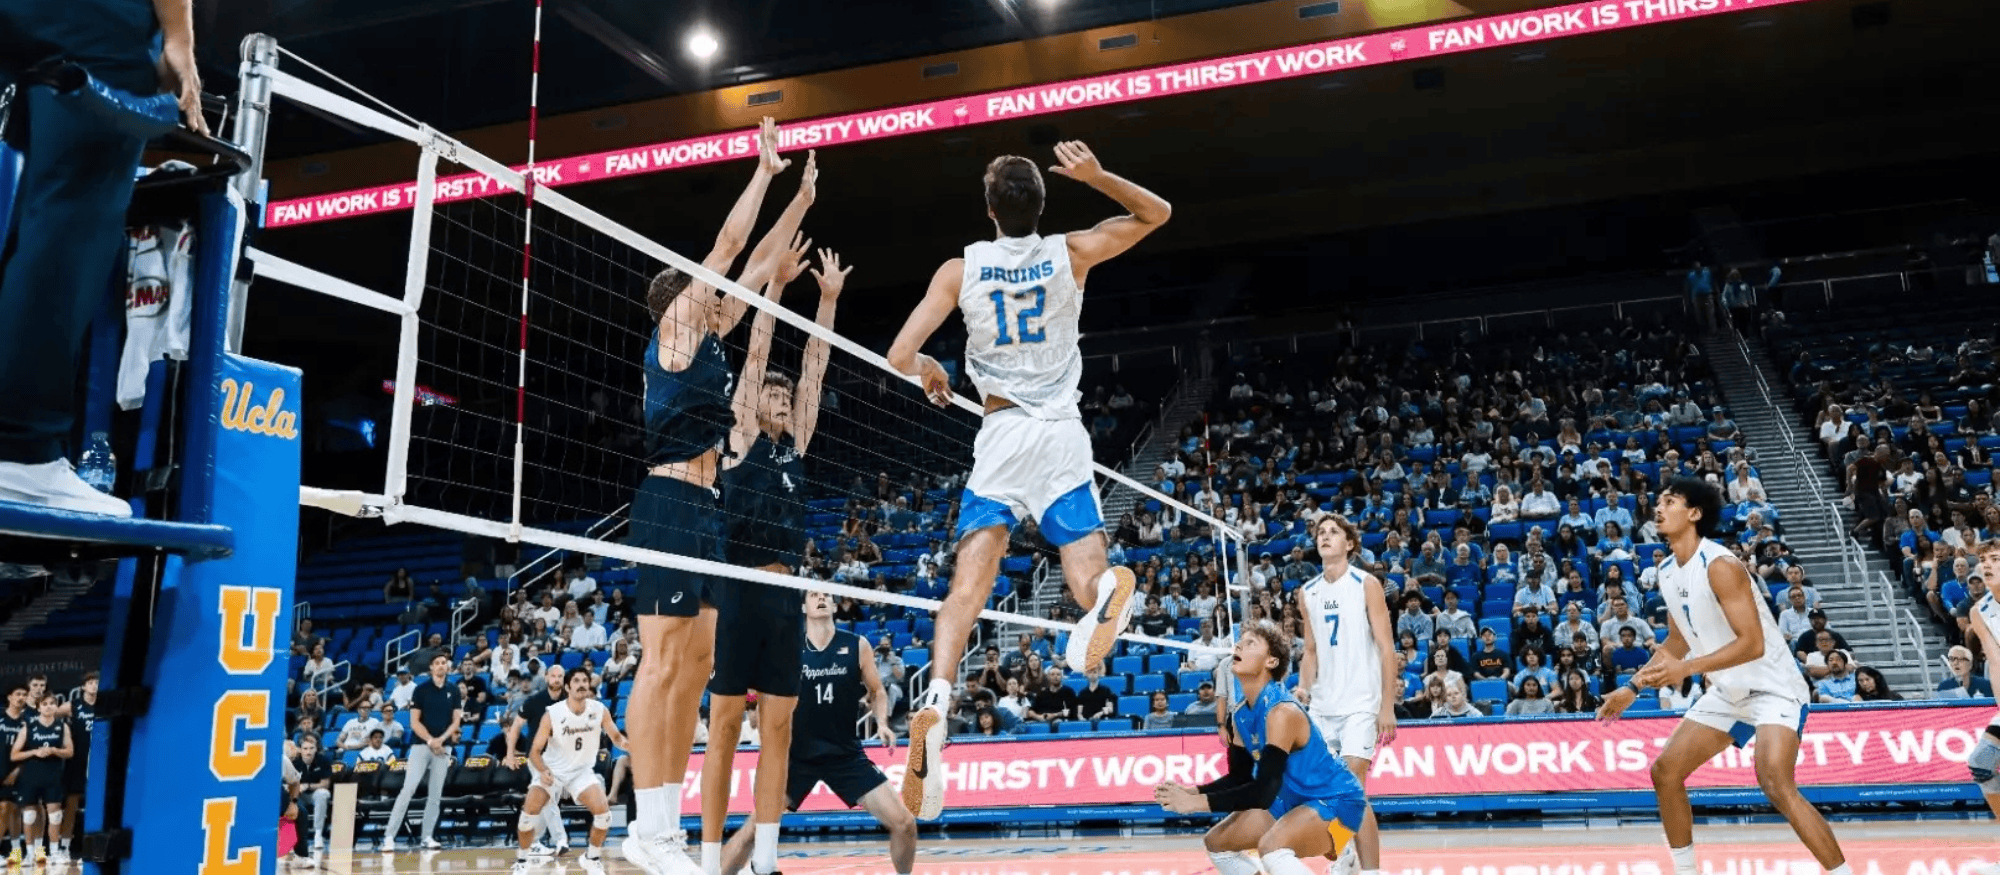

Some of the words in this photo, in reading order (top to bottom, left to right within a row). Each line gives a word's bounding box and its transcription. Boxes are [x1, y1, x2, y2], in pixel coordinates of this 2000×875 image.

[1428, 24, 1486, 52] FAN
[1488, 7, 1588, 42] WORK
[1591, 3, 1621, 27] IS
[986, 91, 1036, 118] FAN
[1040, 78, 1125, 109] WORK
[1127, 74, 1152, 97] IS
[1155, 56, 1272, 92] THIRSTY
[1275, 40, 1368, 74] WORK
[605, 151, 648, 174] FAN
[652, 138, 724, 167] WORK
[727, 135, 750, 155] IS
[857, 108, 935, 136] WORK
[273, 202, 312, 223] FAN
[316, 191, 378, 217] WORK
[382, 187, 401, 207] IS
[980, 259, 1055, 284] BRUINS
[989, 285, 1047, 346] 12
[221, 378, 299, 440] Ucla
[1324, 614, 1339, 647] 7
[1480, 659, 1502, 668] UCLA
[814, 682, 835, 705] 14
[574, 737, 583, 751] 6
[1371, 745, 1436, 778] AN
[1443, 740, 1595, 776] WORK
[1602, 738, 1648, 772] IS
[1879, 727, 1986, 765] WO
[941, 757, 1086, 791] HIRSTY
[1091, 752, 1225, 787] WORK
